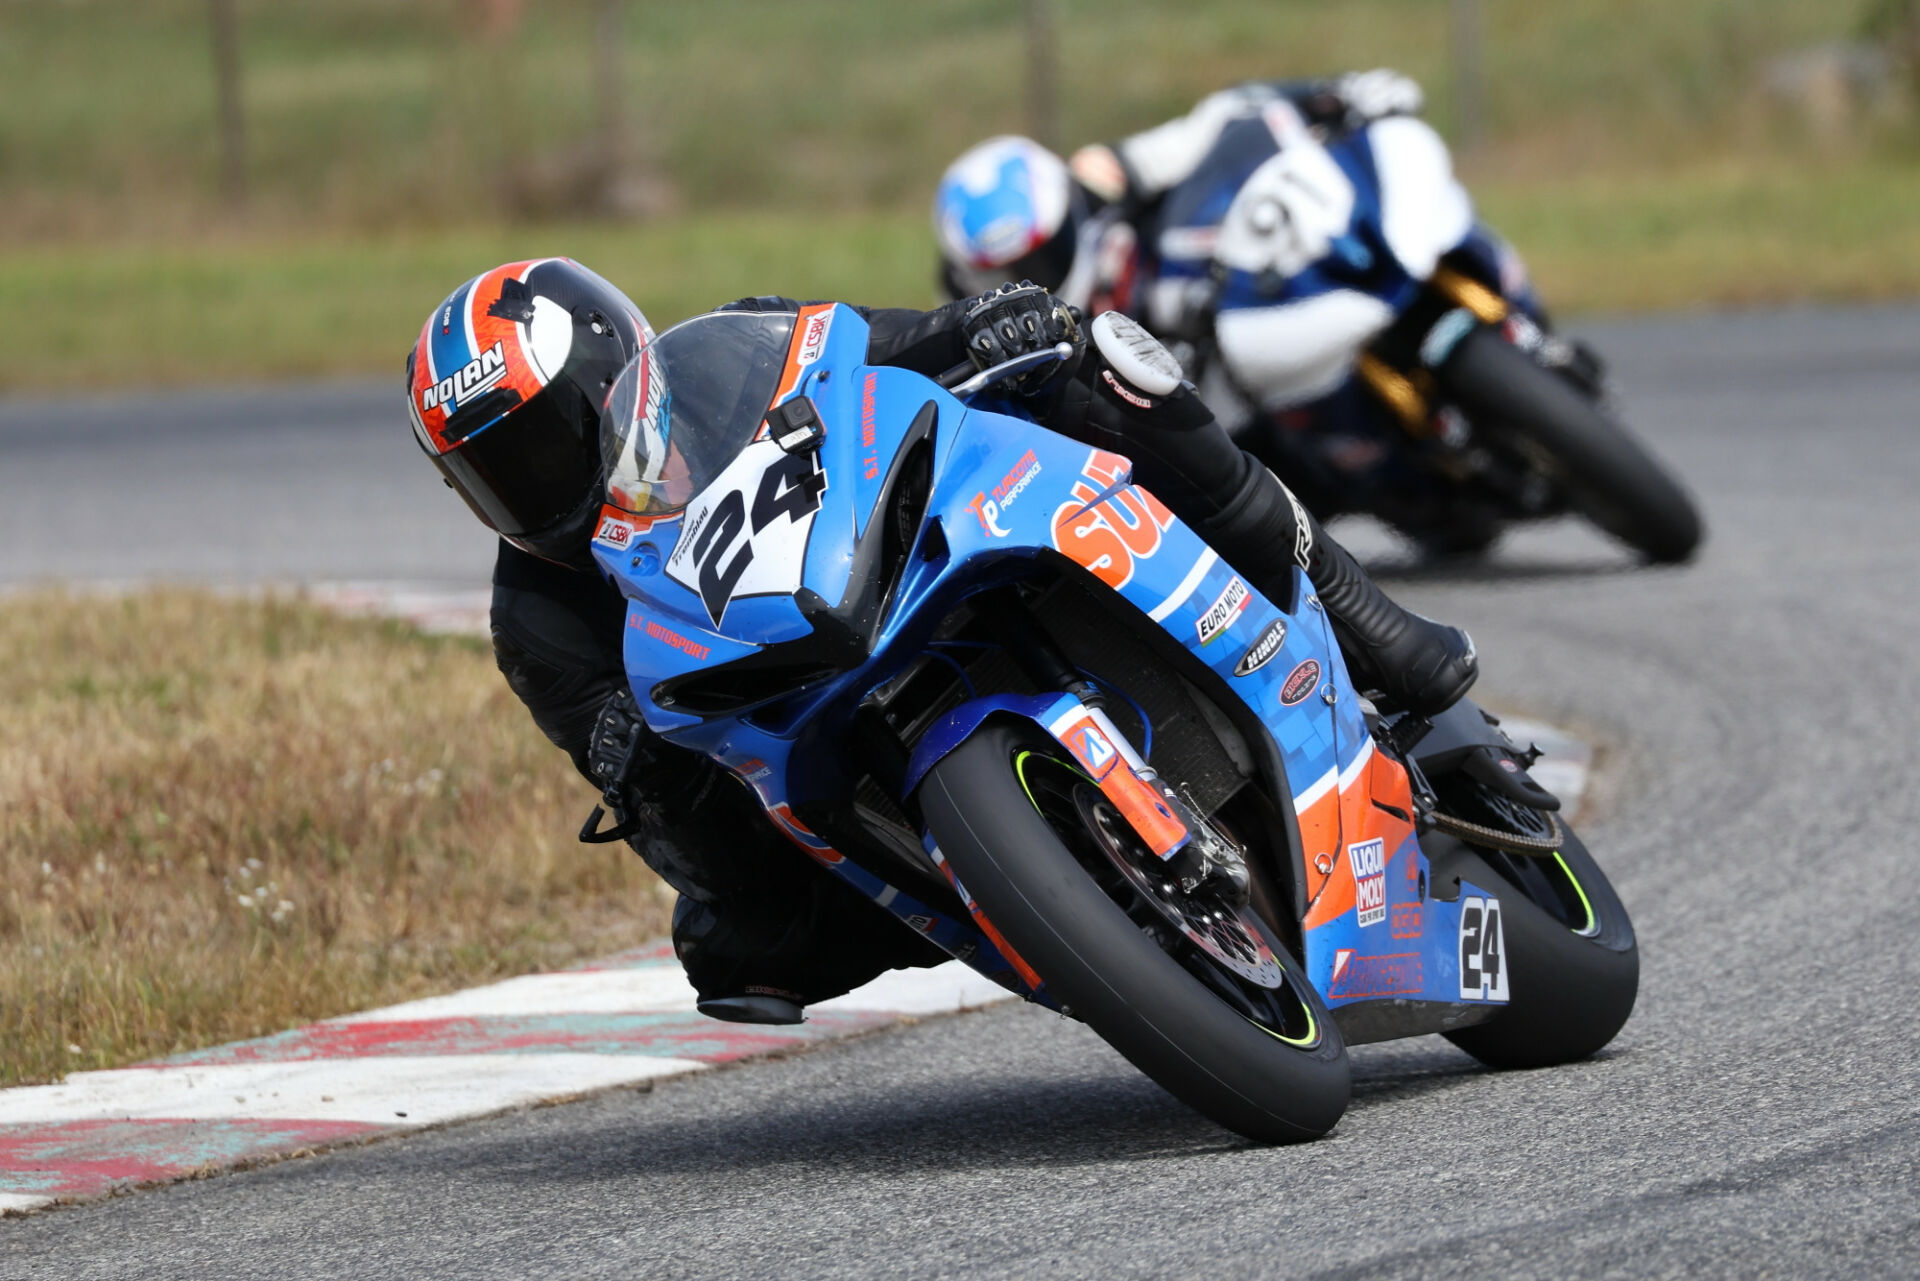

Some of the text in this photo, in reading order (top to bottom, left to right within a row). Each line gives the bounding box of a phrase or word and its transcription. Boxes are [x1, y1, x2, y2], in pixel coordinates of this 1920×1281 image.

[806, 314, 826, 348] CSBK
[423, 340, 507, 412] NOLAN
[861, 372, 878, 447] MOTOSPORT
[991, 448, 1037, 502] TURCOTTE
[1000, 461, 1042, 512] PERFORMANCE
[609, 523, 631, 544] CSBK
[674, 506, 709, 567] Tremblay
[692, 449, 829, 631] 24
[1200, 581, 1244, 638] EURO MOTO
[645, 621, 712, 661] MOTOSPORT
[1247, 621, 1286, 669] HINDLE
[1352, 841, 1384, 874] LIQUI
[1358, 877, 1385, 909] MOLY
[1462, 907, 1500, 990] 24
